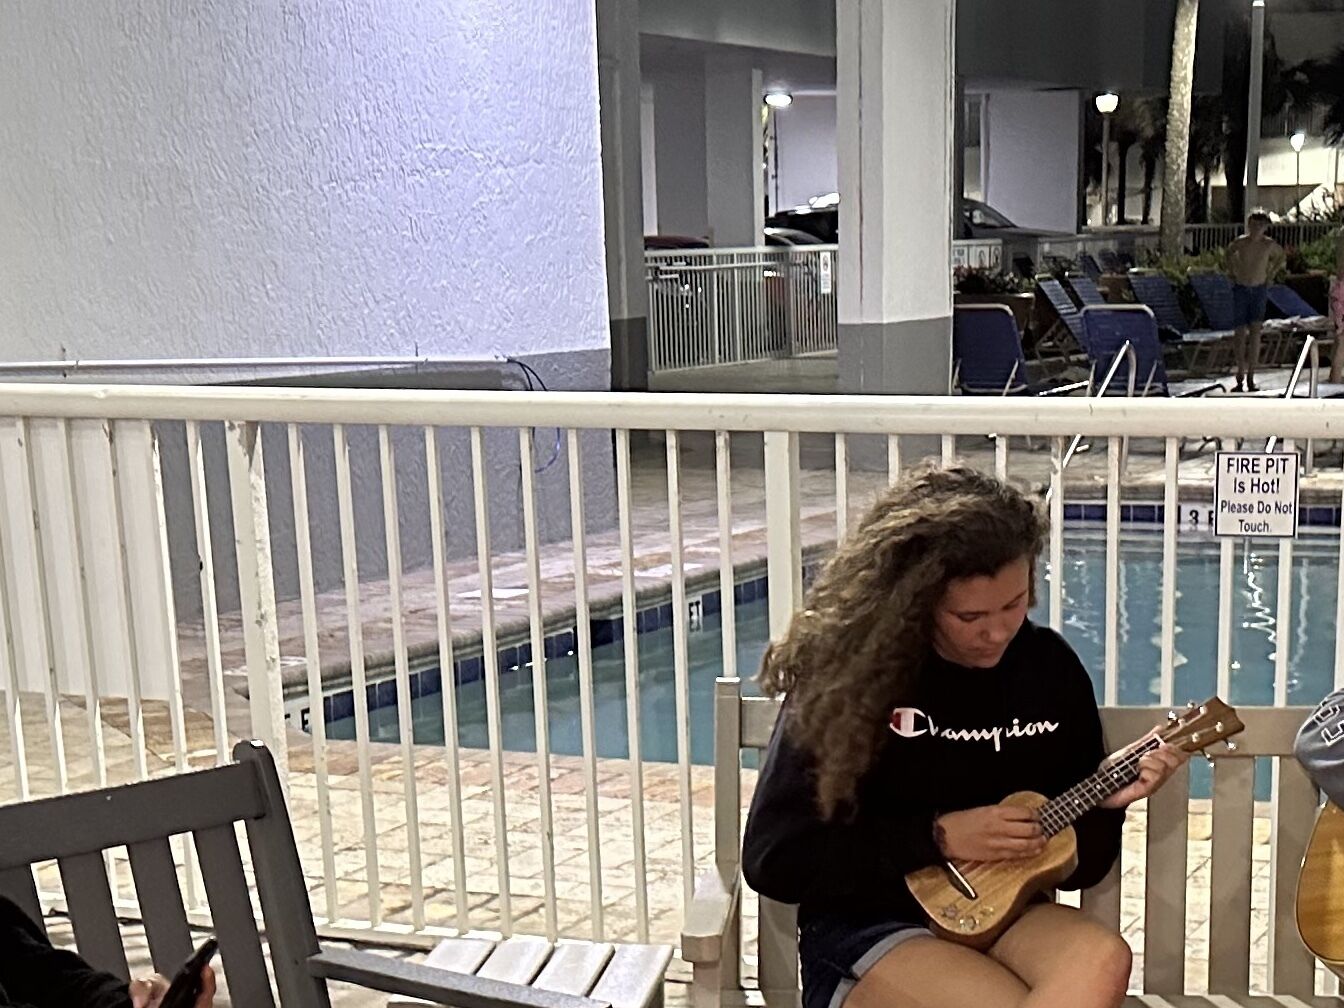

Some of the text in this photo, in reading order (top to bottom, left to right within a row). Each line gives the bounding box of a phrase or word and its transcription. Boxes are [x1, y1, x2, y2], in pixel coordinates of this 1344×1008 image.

[1227, 458, 1289, 474] FIRE PIT
[1233, 478, 1280, 494] Is Hot!
[1220, 500, 1292, 514] Please Do Not
[1238, 519, 1272, 533] Touch.
[890, 707, 1060, 752] Champion
